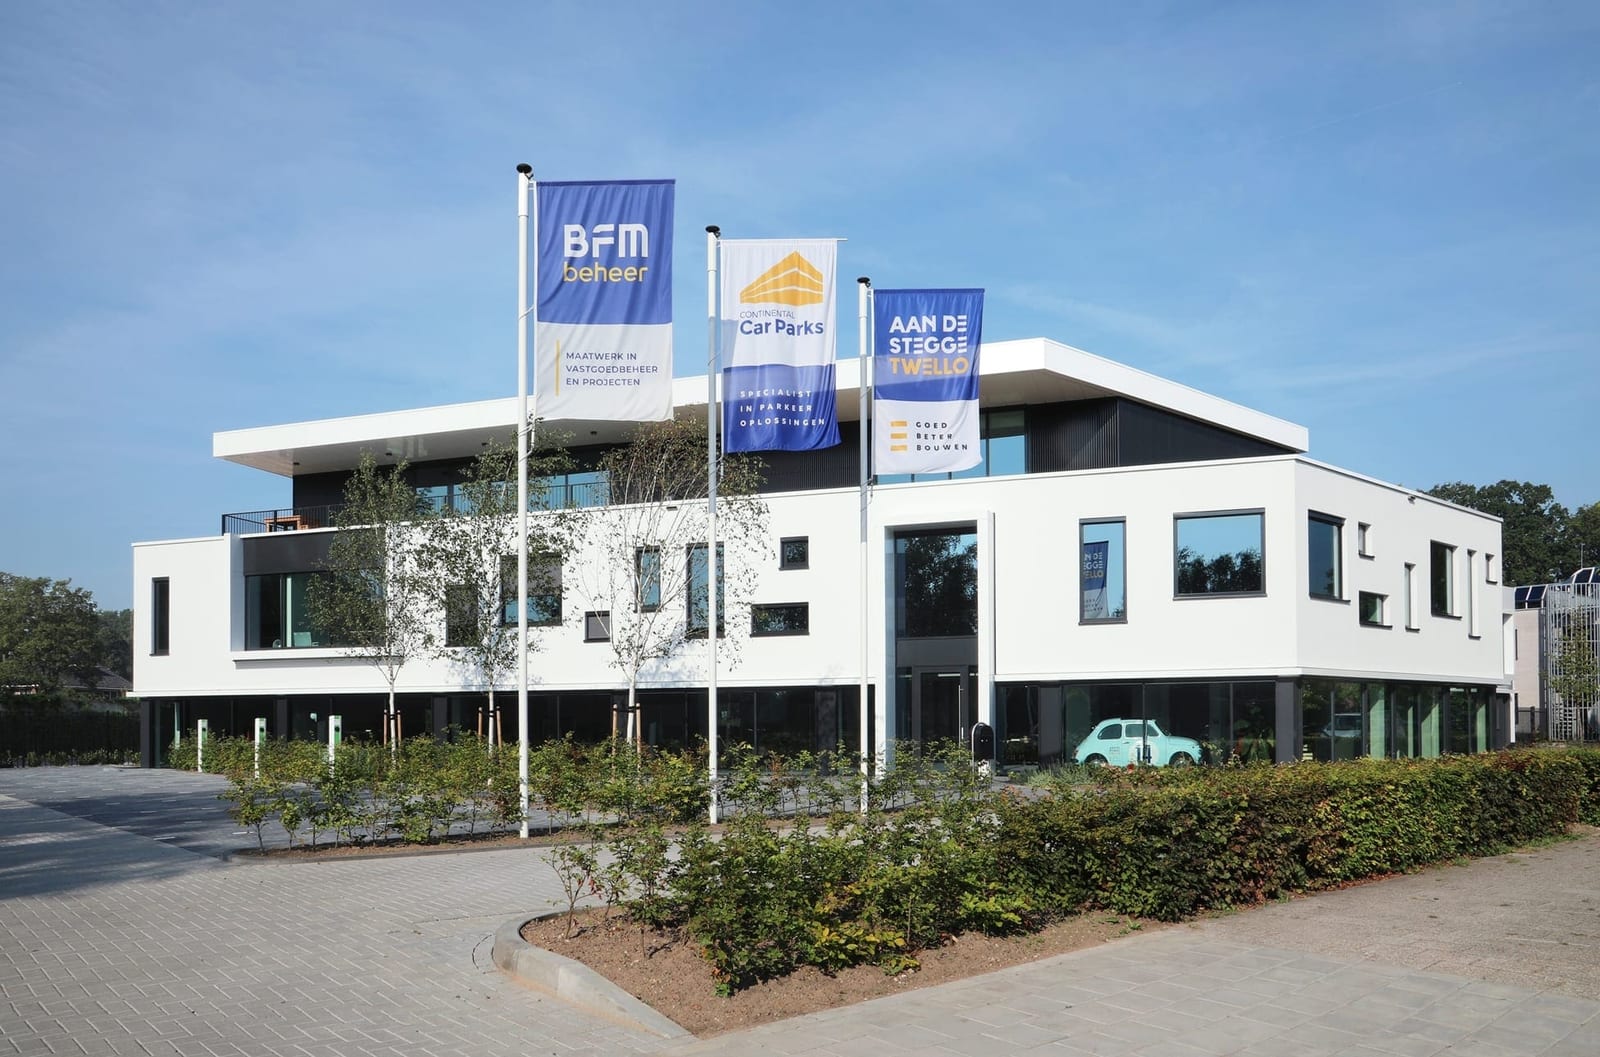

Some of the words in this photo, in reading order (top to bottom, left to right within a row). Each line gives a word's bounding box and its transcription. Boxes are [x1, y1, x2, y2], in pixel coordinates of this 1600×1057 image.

[564, 223, 649, 258] BFM
[563, 262, 649, 282] beheer
[739, 309, 796, 320] CONTINENTAL
[739, 320, 772, 335] Car
[775, 319, 824, 336] Parks
[889, 315, 937, 333] AAN
[943, 314, 968, 333] DE
[889, 335, 968, 355] STEGGE
[566, 351, 624, 361] MAATWERK
[626, 351, 637, 361] IN
[566, 364, 659, 374] VASTGOEDBEHEER
[889, 357, 969, 376] TWELLO
[566, 377, 579, 386] EN
[582, 377, 641, 387] PROJECTEN
[740, 389, 812, 398] SPECIALIST
[740, 404, 753, 412] IN
[759, 402, 813, 412] PARKEER
[739, 418, 825, 427] OPLOSSINGEN
[915, 421, 947, 429] GOED
[916, 432, 953, 440] BETER
[916, 443, 968, 451] BOUWEN
